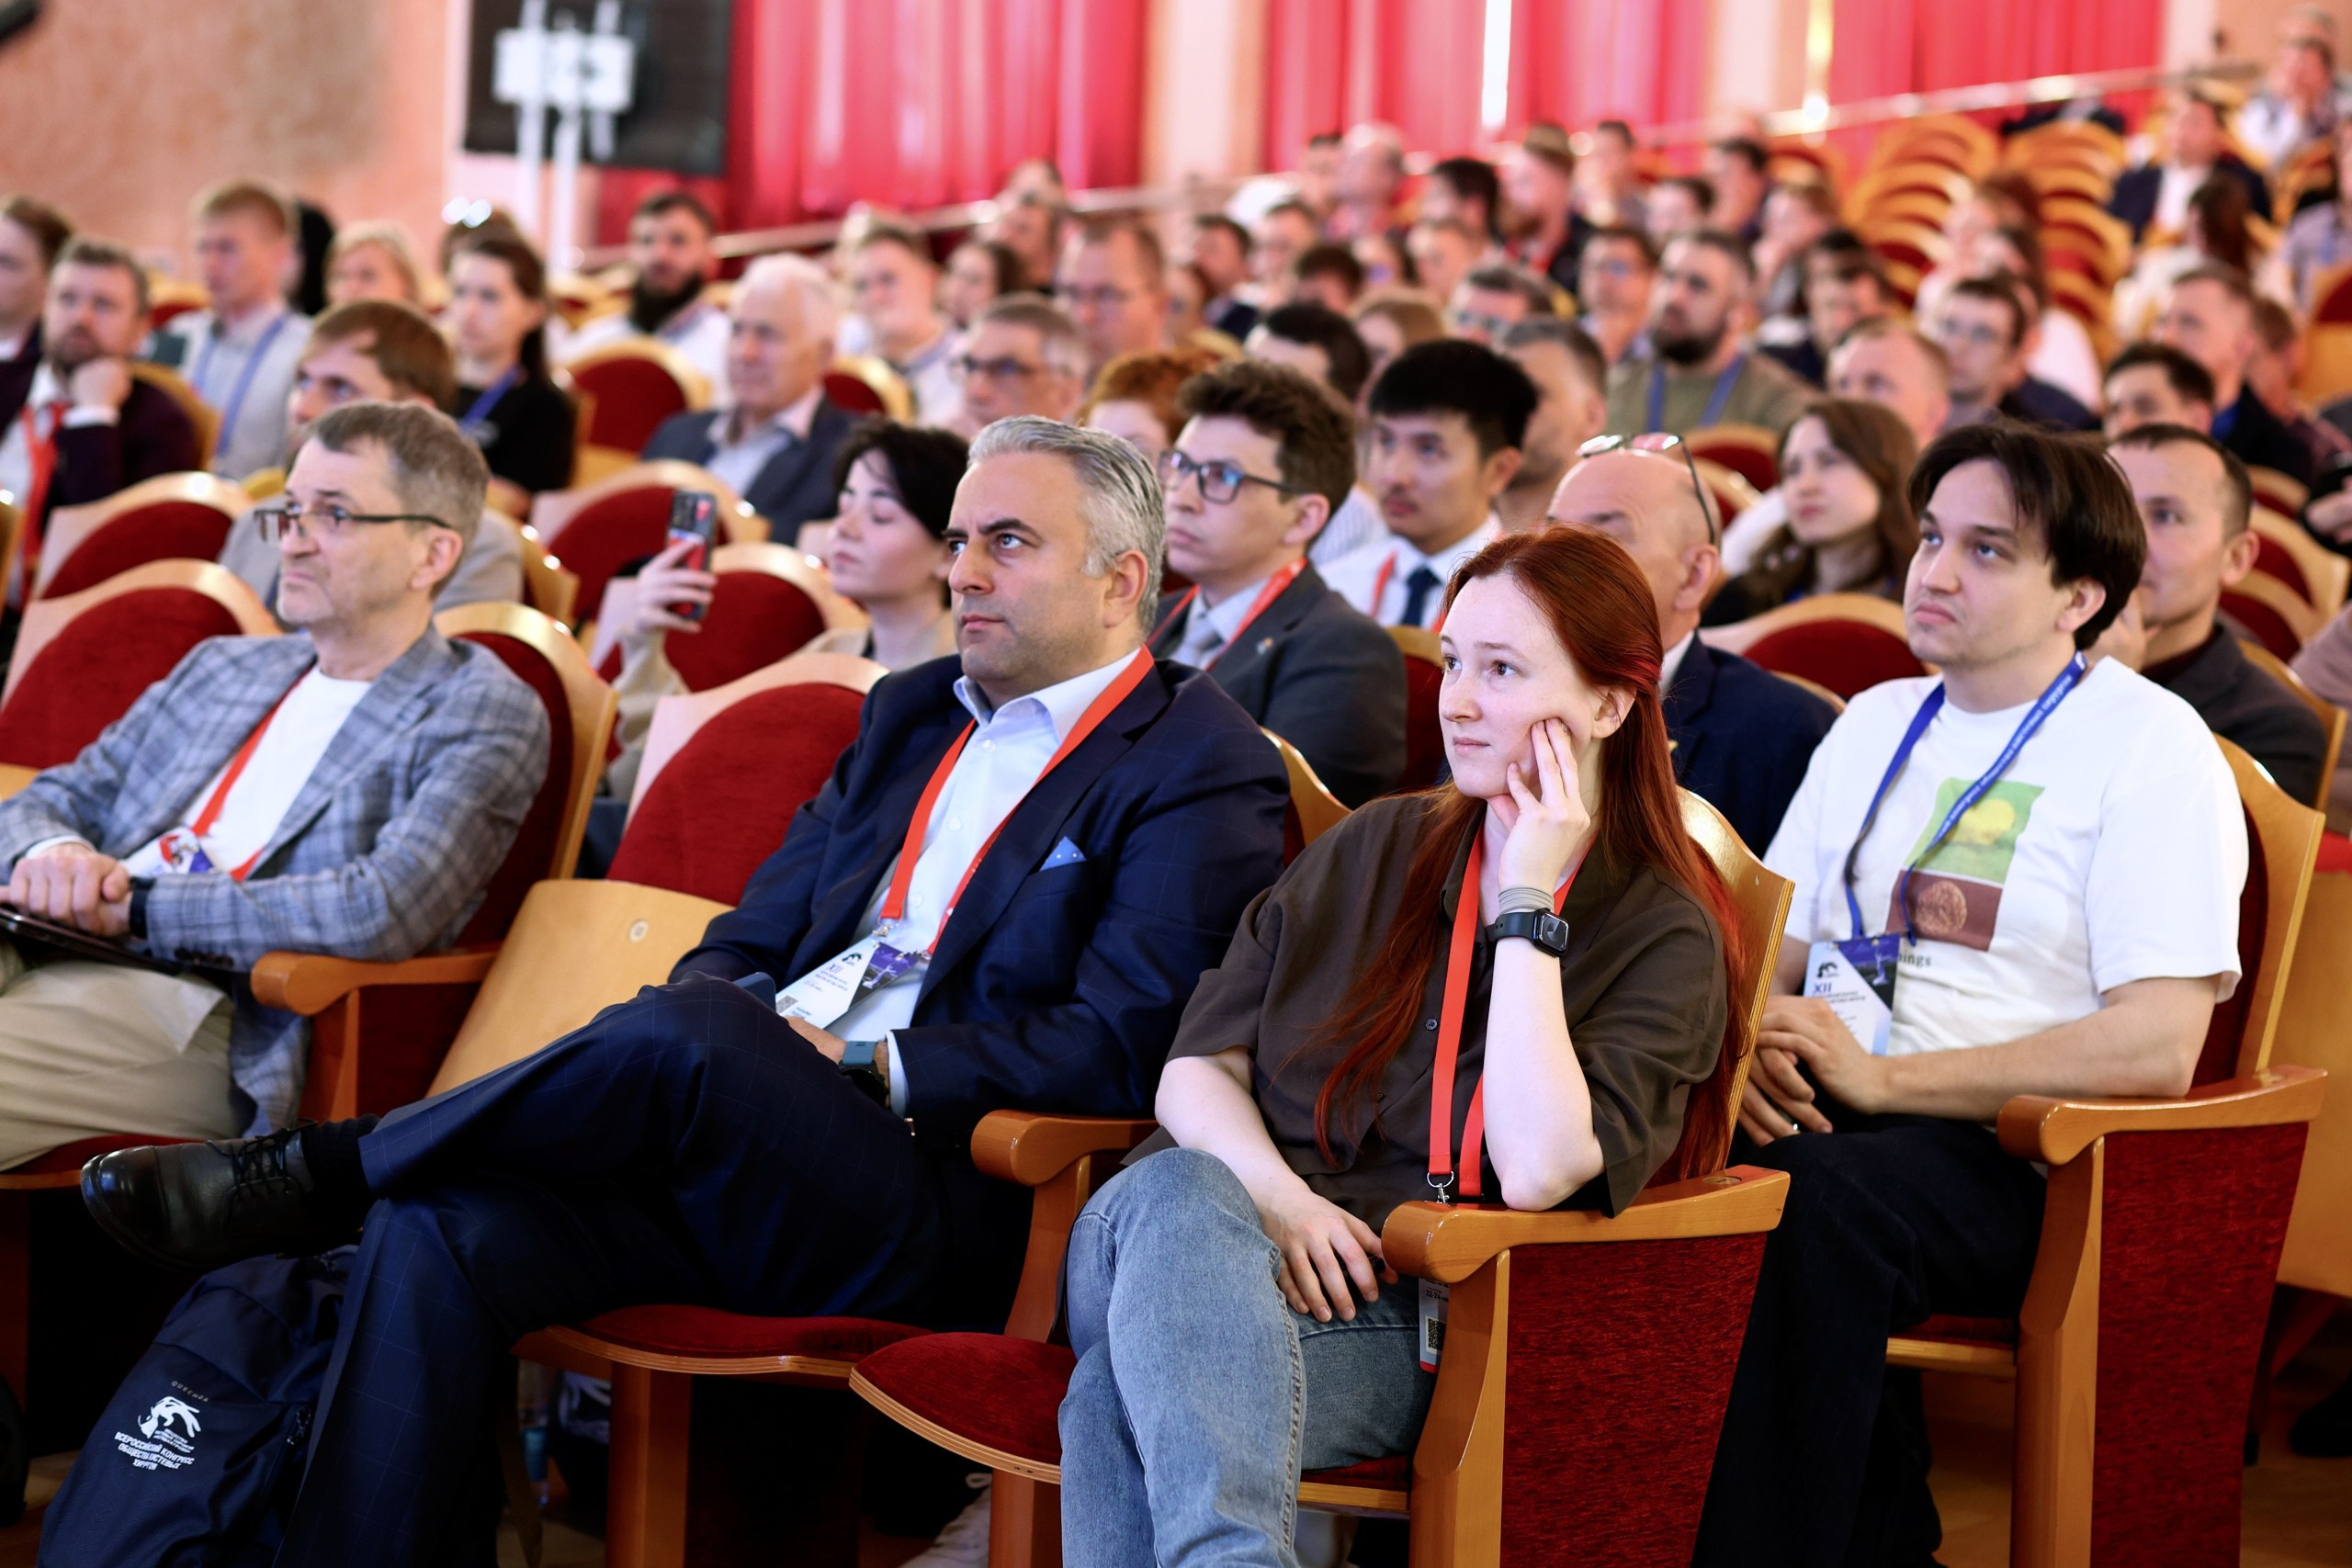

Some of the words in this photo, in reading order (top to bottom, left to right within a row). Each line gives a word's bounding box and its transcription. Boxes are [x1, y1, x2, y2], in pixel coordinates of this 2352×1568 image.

[1813, 983, 1833, 994] XII
[171, 1381, 209, 1403] QUECHUA
[160, 1448, 195, 1464] КОНГРЕСС
